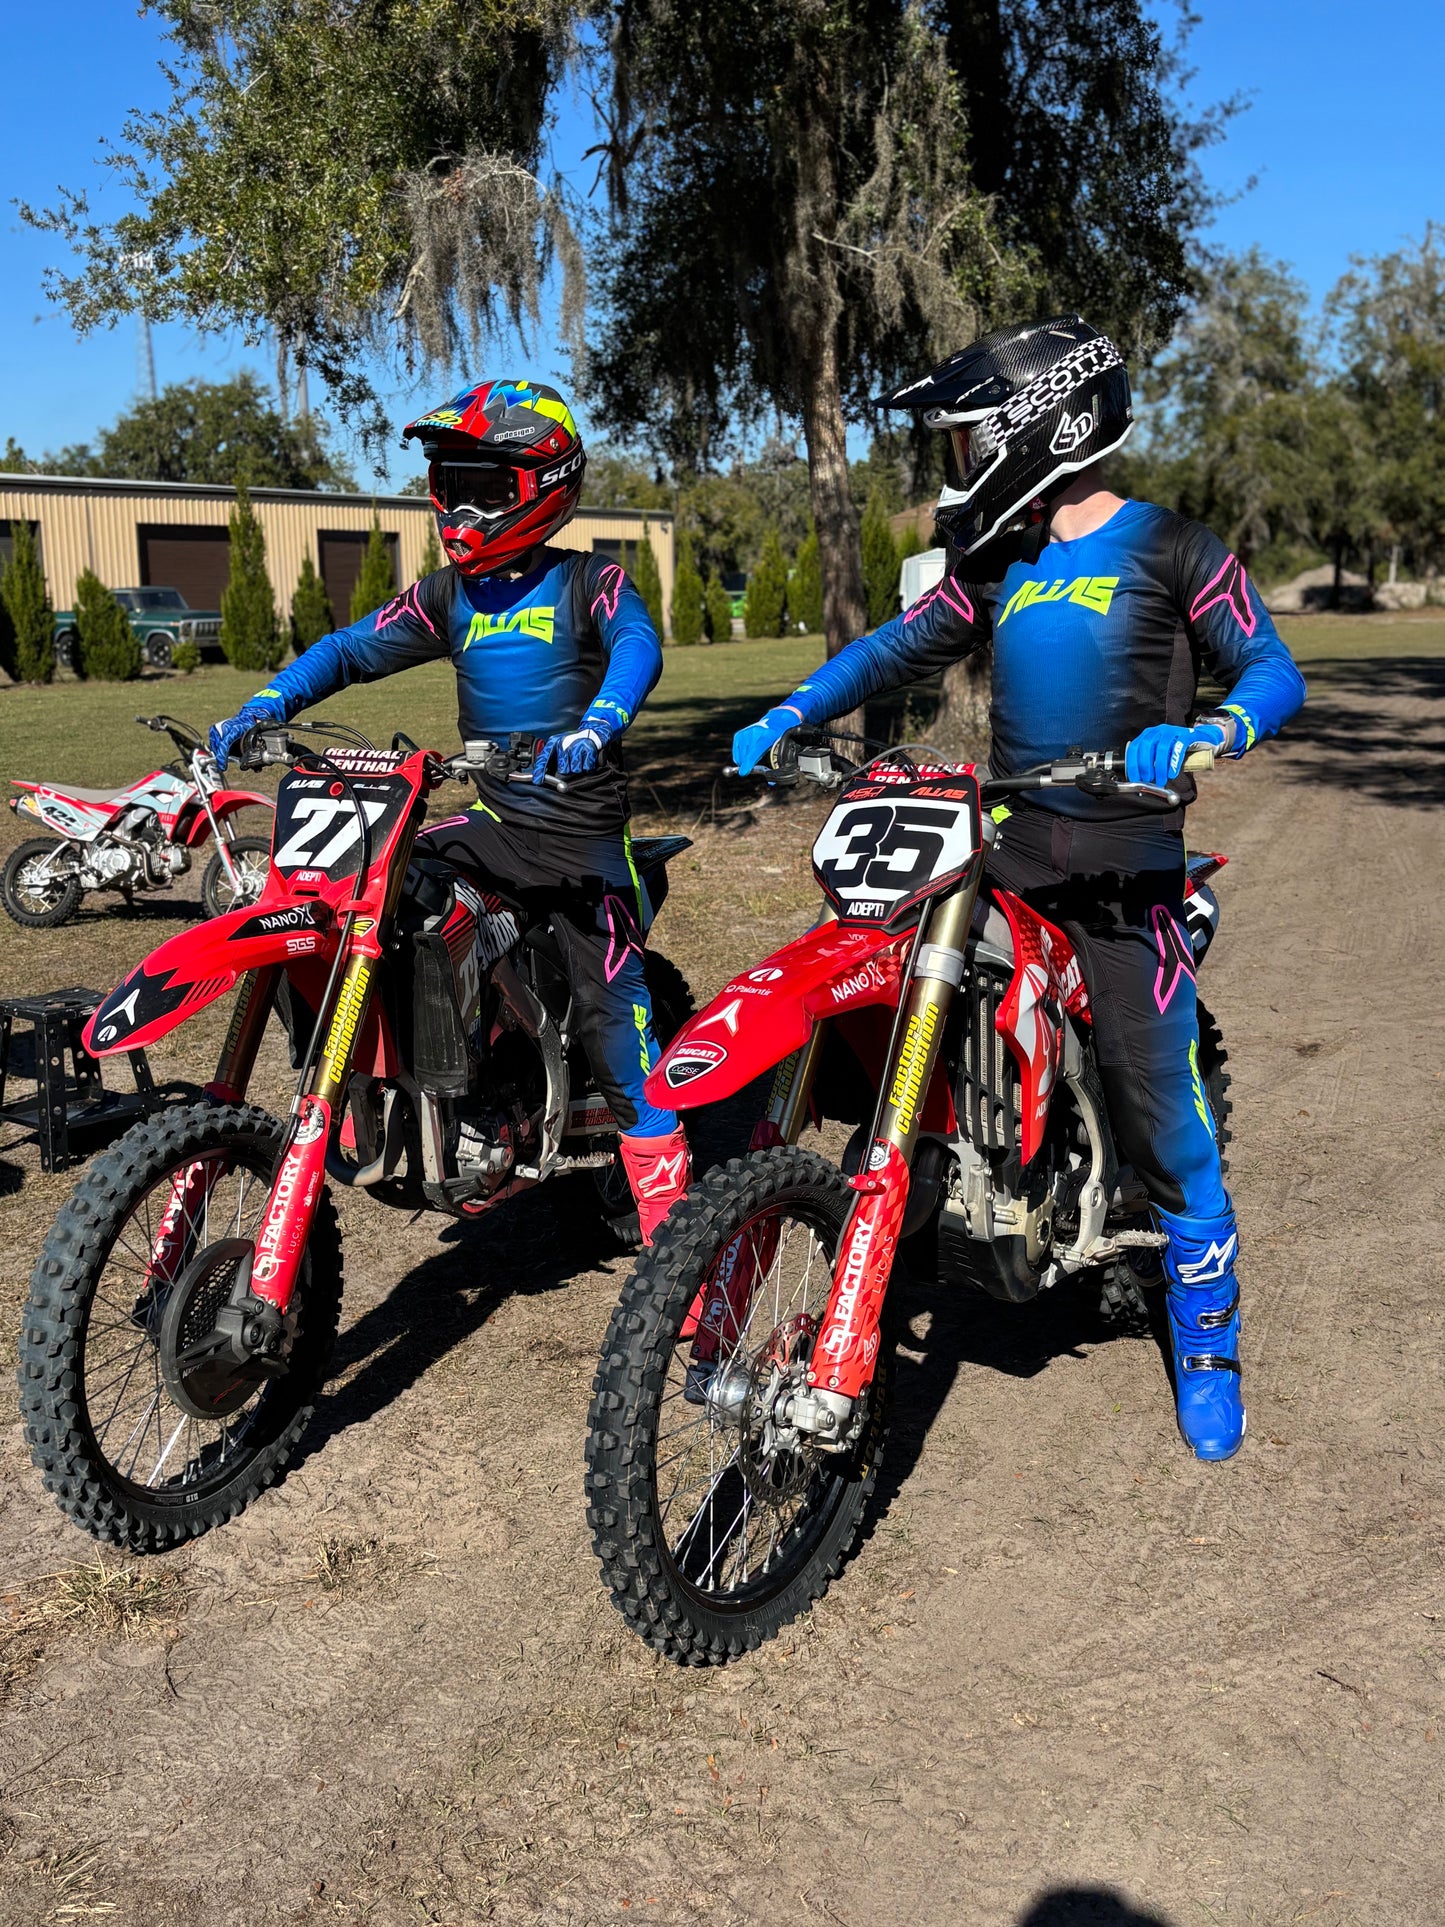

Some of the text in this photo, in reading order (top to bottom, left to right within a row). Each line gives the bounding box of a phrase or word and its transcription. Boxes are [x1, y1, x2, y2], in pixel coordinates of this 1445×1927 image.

[1007, 349, 1099, 421] SCOTT
[494, 426, 535, 442] apdesigns
[539, 450, 585, 489] SCO
[997, 576, 1120, 628] ALIAS
[463, 606, 555, 653] ALIAS
[325, 747, 402, 760] RENTHAL
[908, 786, 969, 800] ALIAS
[274, 797, 388, 868] 27
[821, 805, 960, 891] 35
[286, 936, 316, 952] SGS
[734, 984, 773, 996] Palantir
[323, 977, 354, 1061] Factory
[671, 1065, 701, 1075] CORSE
[676, 1047, 718, 1059] DUCATI
[889, 1014, 922, 1108] Factory
[260, 1152, 302, 1252] FACTORY
[287, 1217, 304, 1254] LUCAS
[833, 1216, 875, 1322] FACTORY
[872, 1235, 894, 1294] LUCAS
